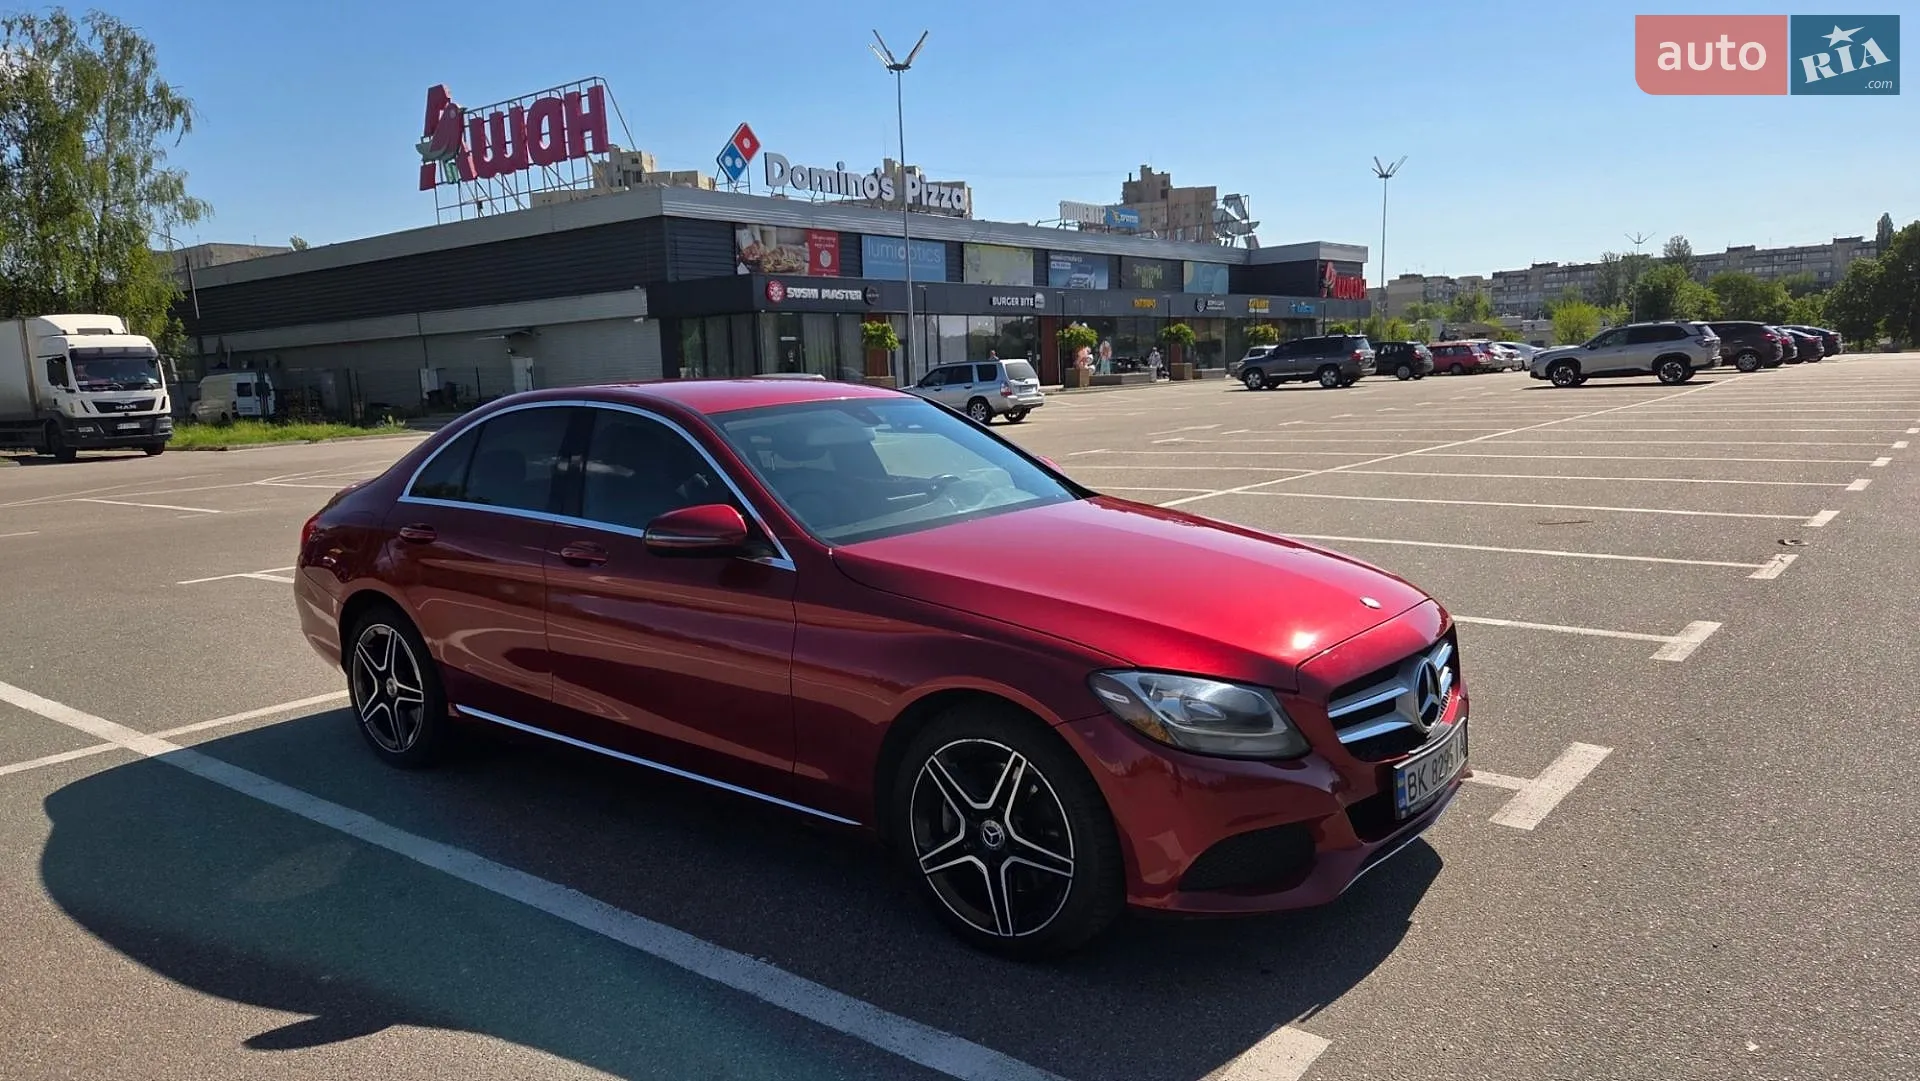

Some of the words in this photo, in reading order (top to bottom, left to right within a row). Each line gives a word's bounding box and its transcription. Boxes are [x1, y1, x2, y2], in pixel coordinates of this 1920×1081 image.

[764, 152, 896, 202] Domino's
[905, 174, 967, 211] Pizza
[867, 238, 942, 264] lumioptics
[786, 287, 819, 300] SUSHI
[821, 288, 862, 301] MASTER
[992, 296, 1019, 306] BURGER
[1020, 297, 1034, 306] BITE
